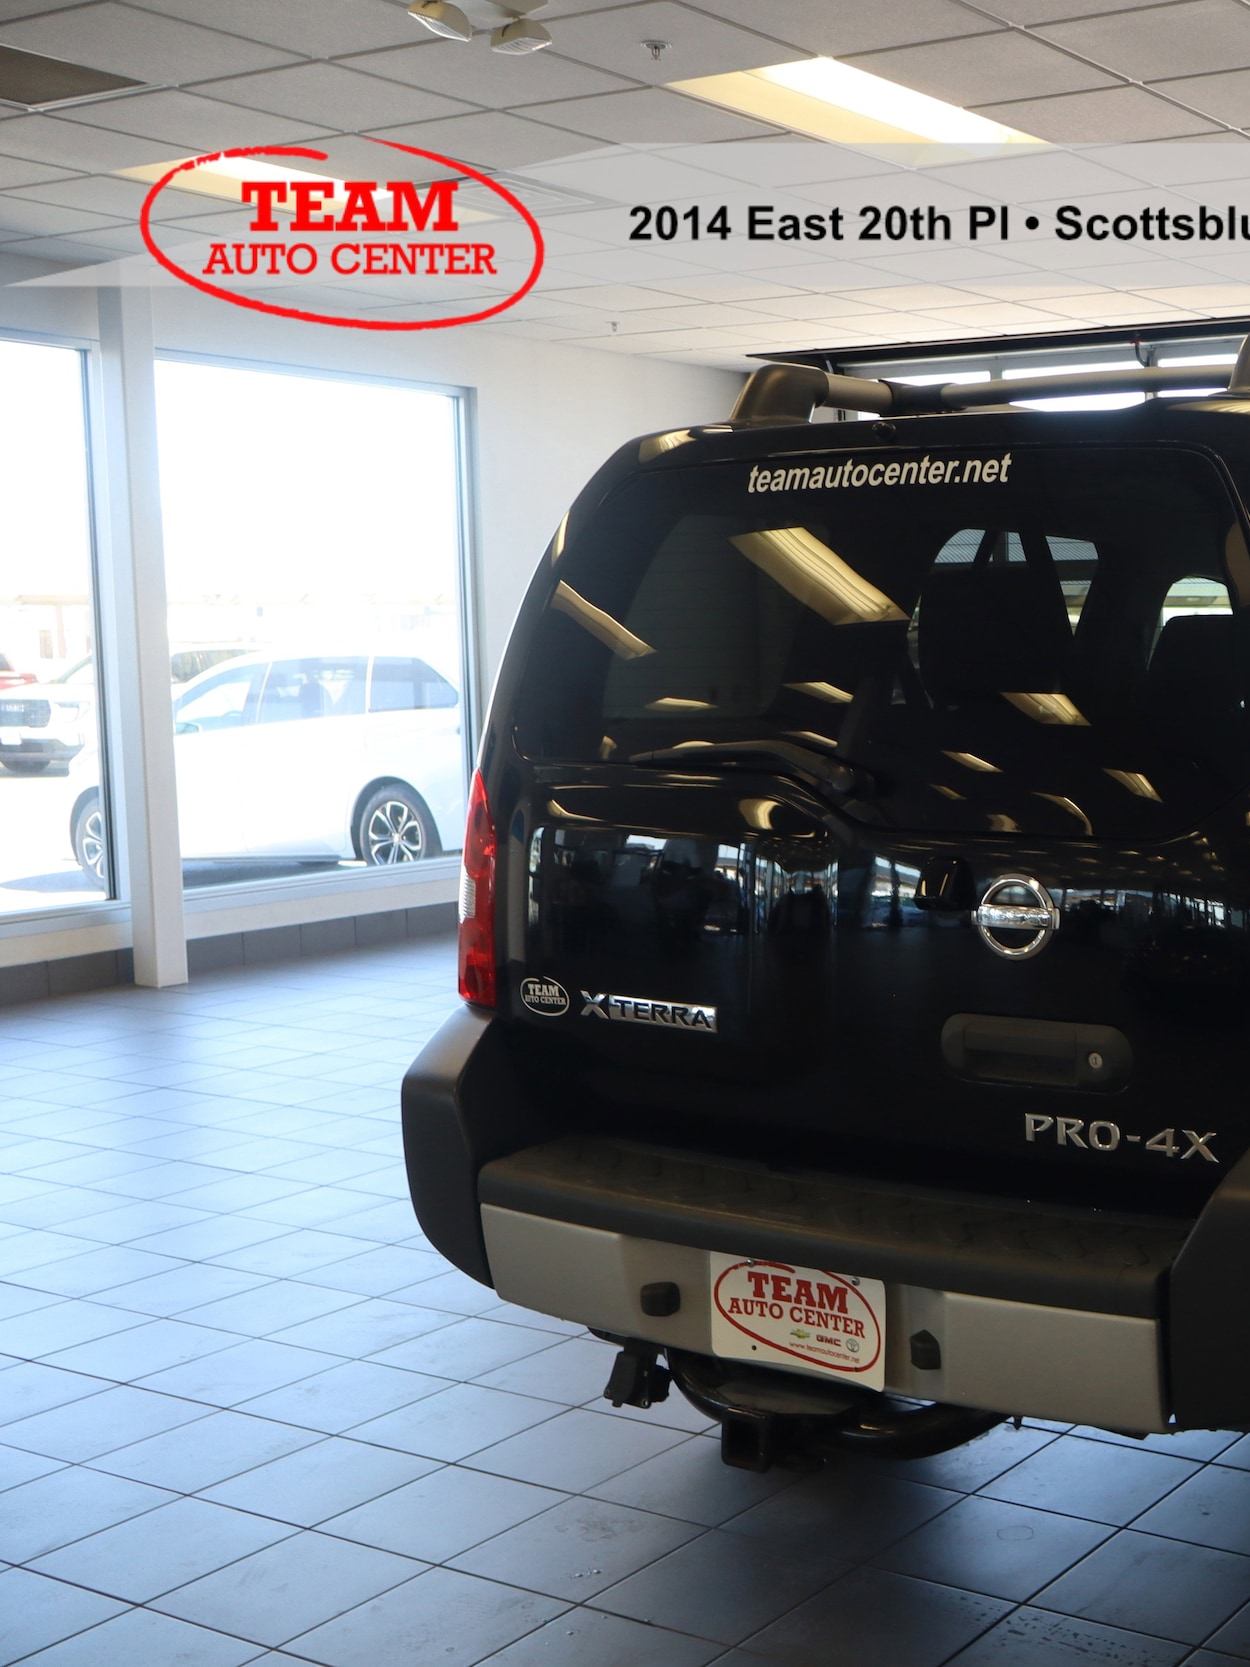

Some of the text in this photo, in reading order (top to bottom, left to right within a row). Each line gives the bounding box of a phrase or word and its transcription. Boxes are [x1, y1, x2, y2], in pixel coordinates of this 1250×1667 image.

[747, 452, 1012, 493] teamautocenter.net
[527, 983, 560, 997] TEAM
[540, 996, 567, 1005] CENTER
[580, 990, 718, 1033] XTERRA
[1024, 1112, 1220, 1164] PRO-4X
[747, 1271, 848, 1315] TEAM
[728, 1297, 866, 1339] AUTO CENTER
[815, 1333, 842, 1347] GMC
